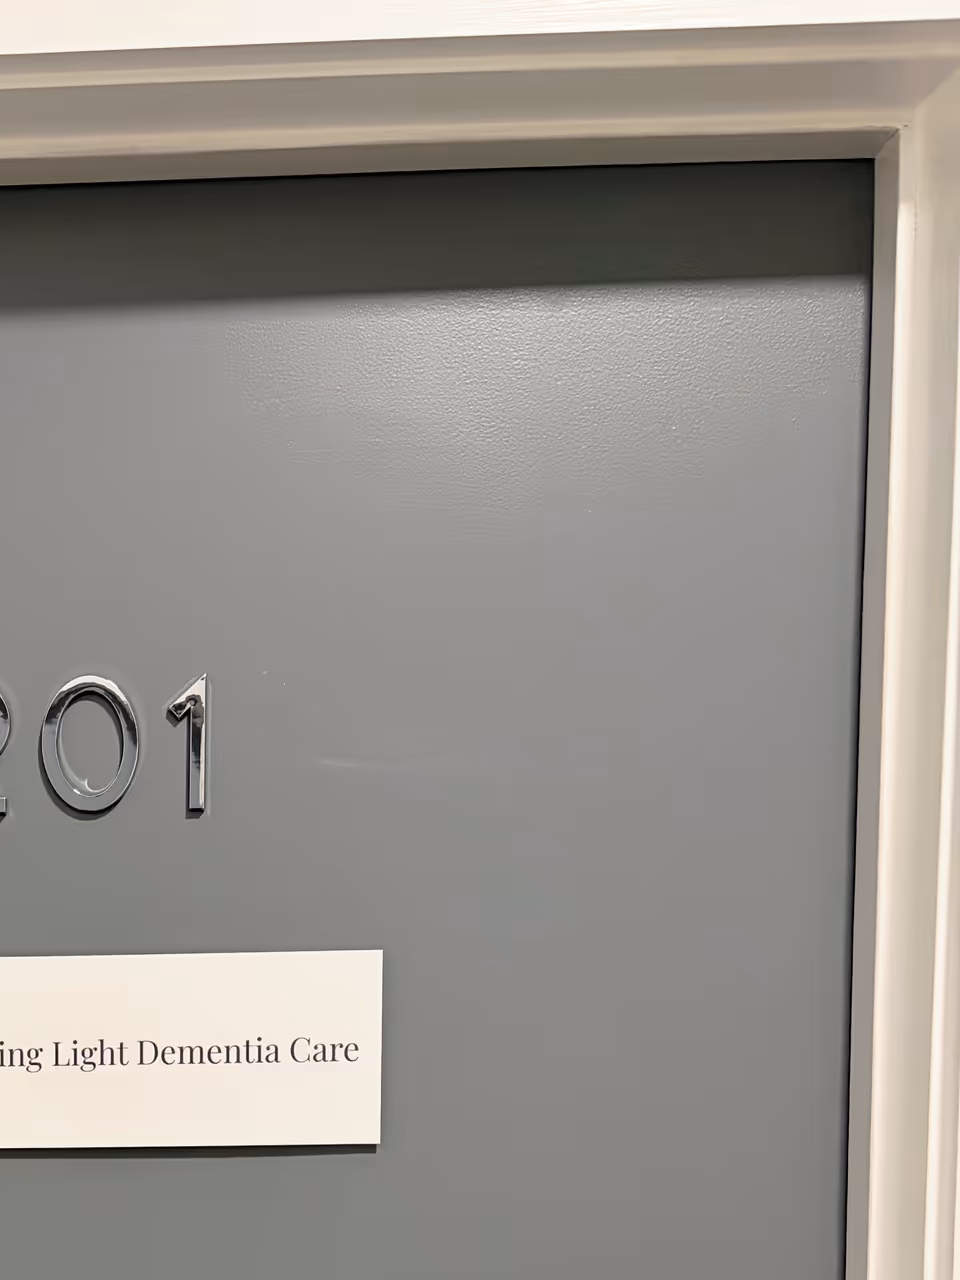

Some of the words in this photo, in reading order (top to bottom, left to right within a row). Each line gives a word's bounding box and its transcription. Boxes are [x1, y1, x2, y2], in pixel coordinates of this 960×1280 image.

[52, 1038, 129, 1072] Light
[137, 1036, 281, 1066] Dementia
[290, 1036, 360, 1063] Care
